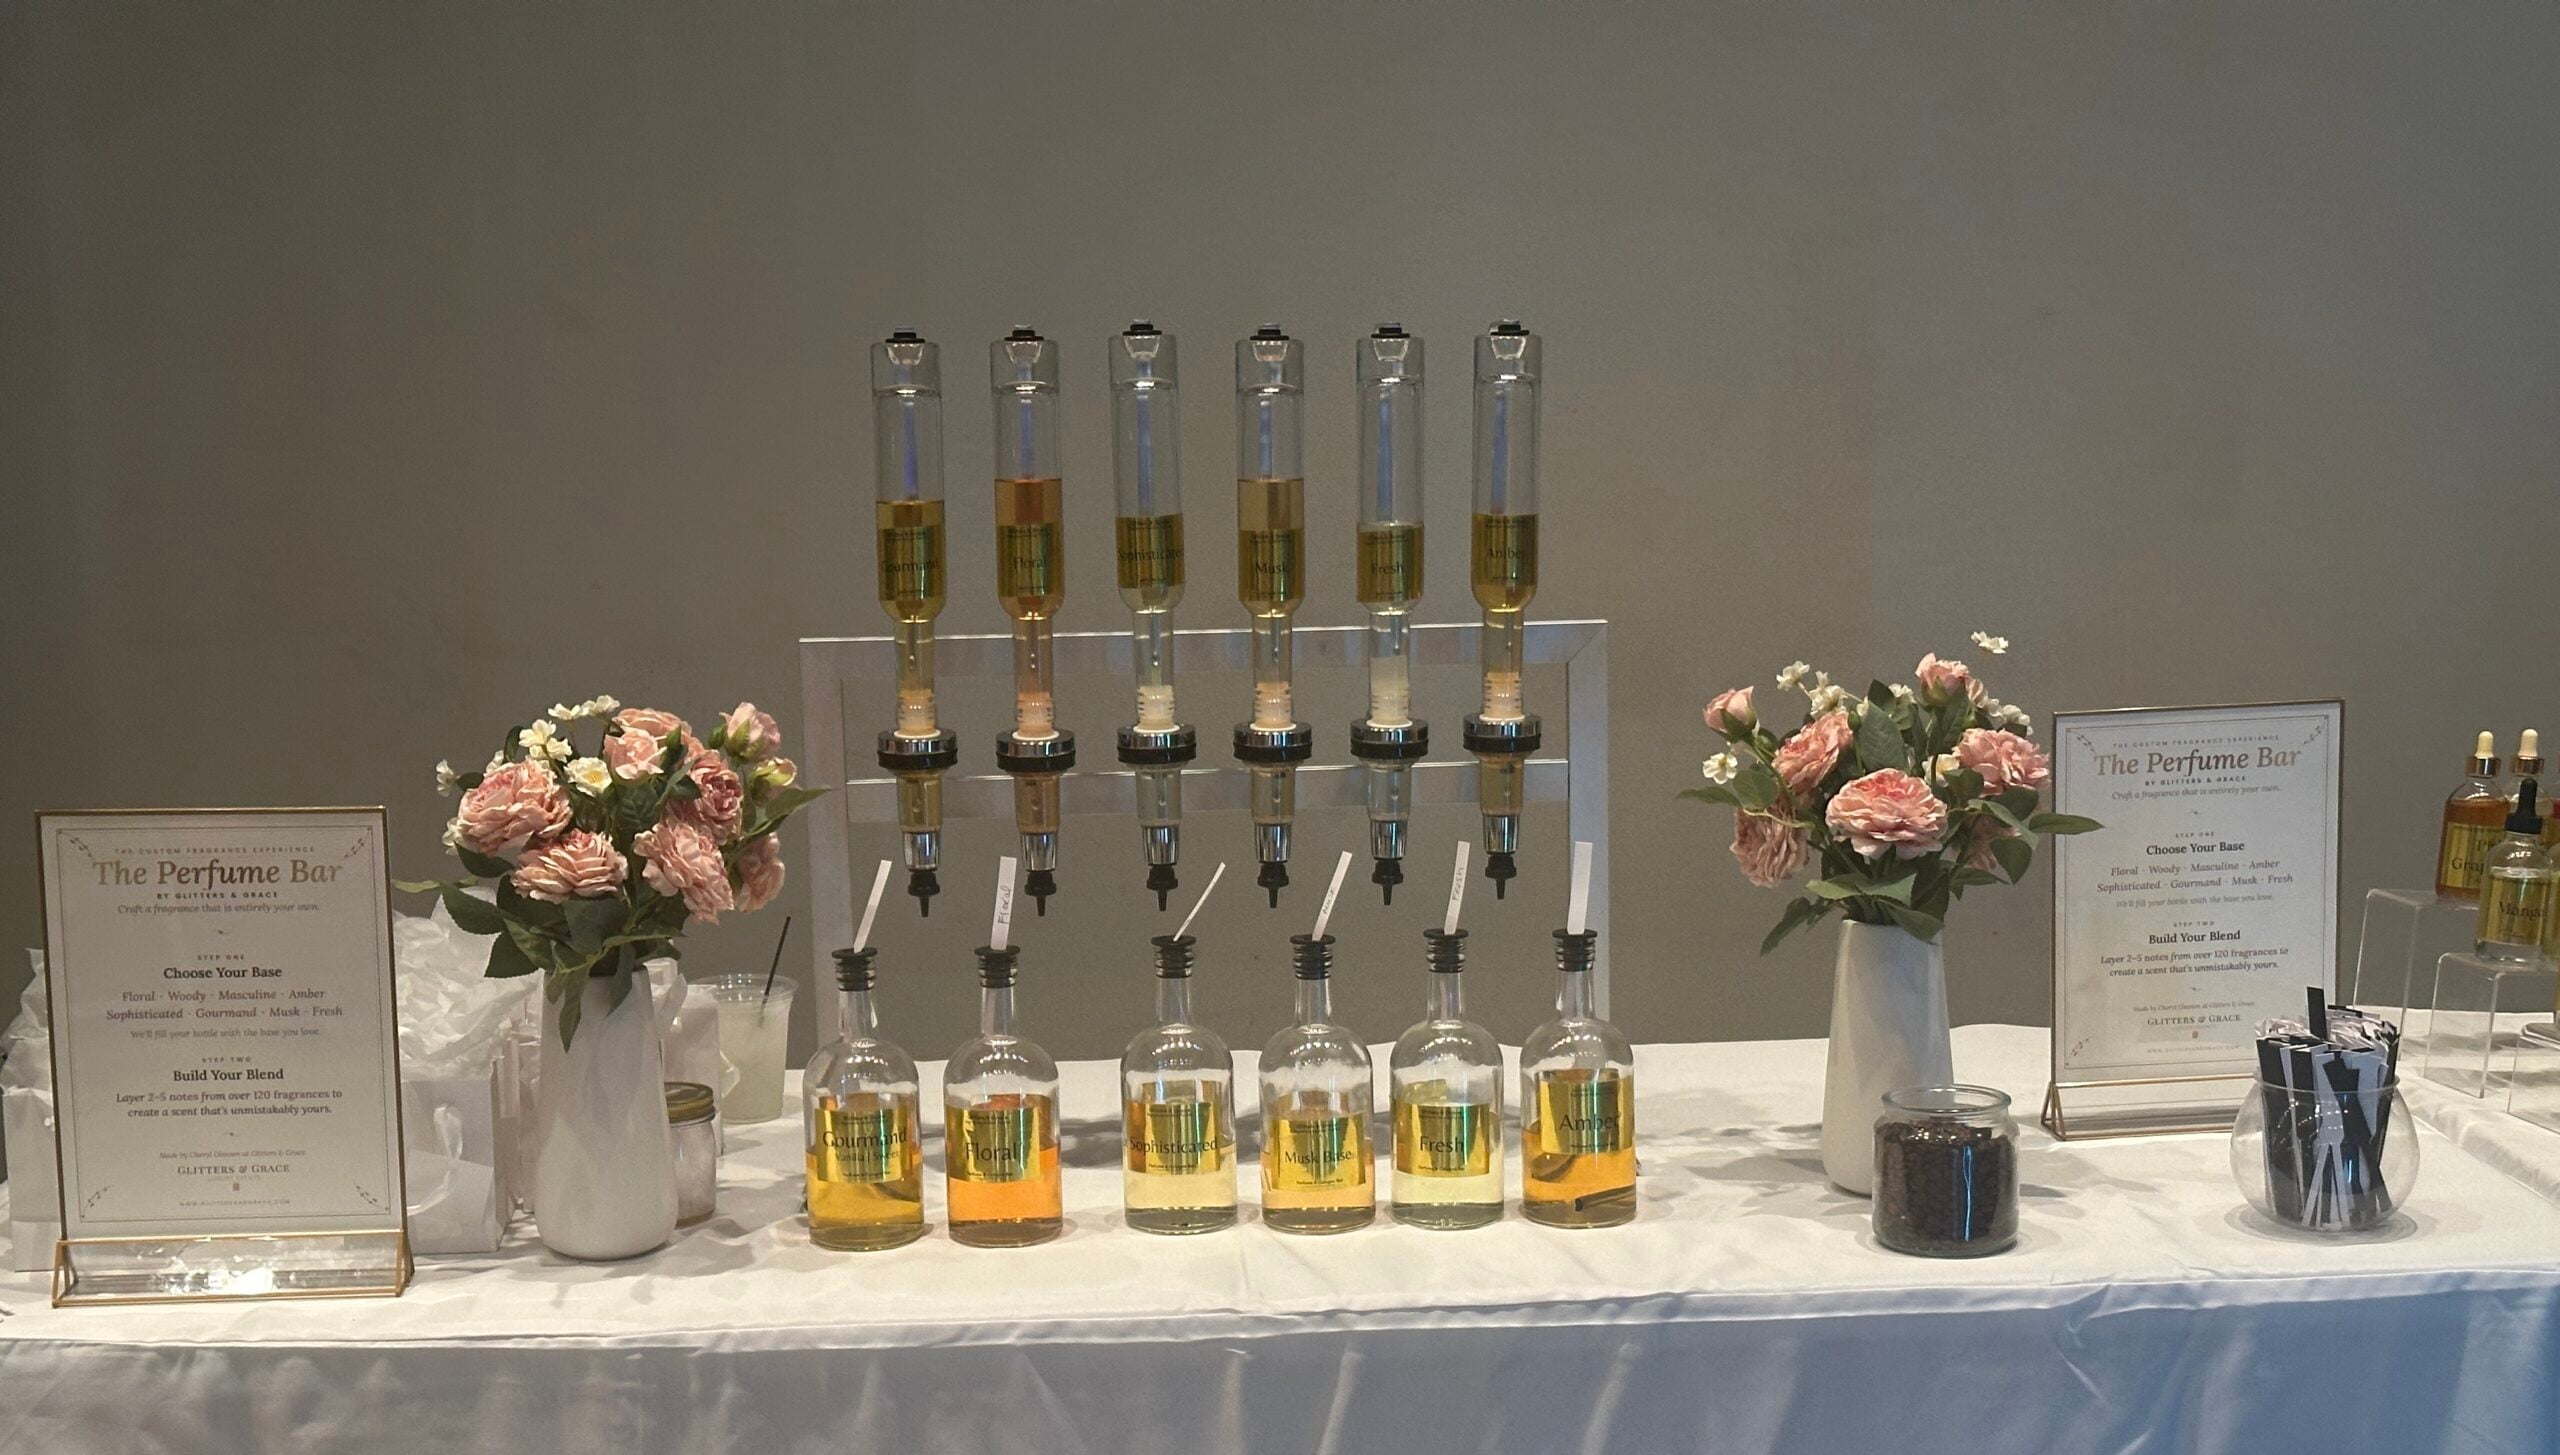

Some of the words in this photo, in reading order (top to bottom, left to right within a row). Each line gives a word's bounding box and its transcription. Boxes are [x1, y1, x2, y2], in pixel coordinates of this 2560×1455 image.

[1371, 560, 1405, 575] Fresh
[2094, 753, 2138, 775] The
[2146, 749, 2248, 777] Perfume
[2257, 746, 2301, 768] Bar
[2146, 845, 2187, 855] Choose
[2190, 843, 2217, 853] Your
[2219, 842, 2245, 852] Base
[93, 859, 148, 885] The
[157, 858, 280, 890] Perfume
[290, 859, 342, 883] Bar
[2111, 866, 2138, 876] Floral
[2149, 864, 2180, 876] Woody
[2190, 862, 2239, 872] Masculine
[2248, 860, 2280, 869] Amber
[2097, 881, 2161, 894] Sophisticated
[2170, 878, 2222, 889] Gourmand
[2232, 875, 2258, 886] Musk
[2267, 874, 2293, 884] Fresh
[117, 904, 142, 914] Craft
[154, 904, 199, 915] fragrance
[2149, 933, 2177, 944] Build
[2180, 932, 2206, 942] Your
[2209, 930, 2240, 941] Blend
[2101, 956, 2125, 965] Layer
[2144, 953, 2168, 962] notes
[2169, 952, 2191, 963] from
[2214, 950, 2228, 958] 120
[2231, 948, 2278, 959] fragrances
[164, 967, 212, 979] Choose
[216, 966, 248, 978] Your
[252, 966, 282, 977] Base
[2109, 968, 2136, 977] create
[2145, 966, 2167, 975] scent
[122, 991, 155, 1002] Floral
[168, 990, 206, 1003] Woody
[218, 989, 277, 1000] Masculine
[288, 988, 325, 999] Amber
[106, 1008, 183, 1022] Sophisticated
[195, 1007, 257, 1018] Gourmand
[269, 1007, 300, 1017] Musk
[312, 1005, 343, 1016] Fresh
[2147, 1016, 2195, 1026] GLITTERS
[2208, 1014, 2241, 1022] GRACE
[173, 1069, 207, 1081] Build
[211, 1069, 242, 1081] Your
[246, 1068, 284, 1080] Blend
[116, 1093, 145, 1105] Layer
[169, 1093, 199, 1102] notes
[201, 1091, 225, 1103] from
[228, 1092, 250, 1100] over
[254, 1090, 271, 1100] 120
[274, 1090, 330, 1101] fragrances
[332, 1090, 343, 1098] to
[127, 1108, 159, 1117] create
[171, 1107, 197, 1116] scent
[231, 1104, 299, 1116] unmistakably
[1559, 1113, 1620, 1131] Amber
[823, 1126, 906, 1148] Gourmand
[1420, 1136, 1464, 1152] Fresh
[966, 1142, 1017, 1161] Floral
[1130, 1136, 1217, 1156] Sophisticated
[1285, 1151, 1319, 1164] Musk
[1323, 1150, 1352, 1162] Base
[177, 1166, 234, 1175] GLITTERS
[238, 1165, 248, 1174] &
[251, 1164, 290, 1173] GRACE
